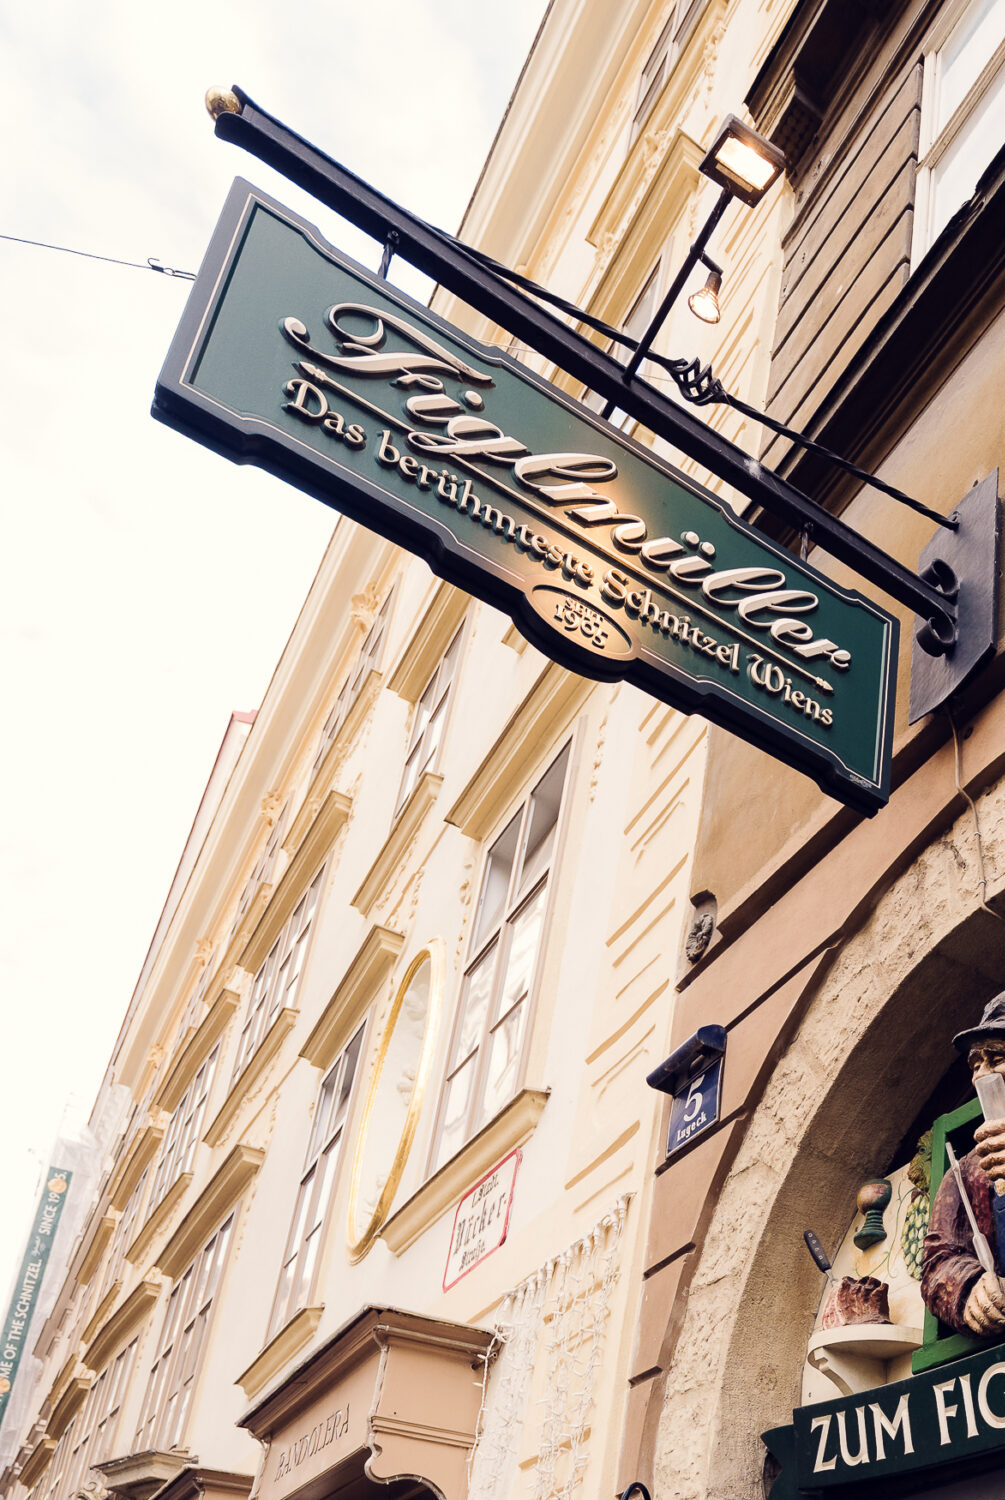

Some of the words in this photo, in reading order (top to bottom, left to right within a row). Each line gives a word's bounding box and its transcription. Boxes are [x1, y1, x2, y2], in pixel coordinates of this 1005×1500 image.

[278, 303, 853, 669] Figlmüller
[283, 378, 366, 447] Das
[379, 429, 596, 588] berühmteste
[601, 567, 741, 673] Schnitzel
[748, 652, 835, 728] Wiens
[565, 597, 604, 624] SEIT
[683, 1074, 706, 1122] 5
[676, 1111, 707, 1141] Lugeck
[48, 1170, 68, 1203] 195.
[38, 1204, 58, 1236] SINCE
[15, 1258, 42, 1319] SCHNITZEL.
[8, 1316, 24, 1342] THE
[3, 1343, 17, 1360] OF
[273, 1403, 351, 1483] BANDOLERA
[810, 1393, 915, 1474] ZUM
